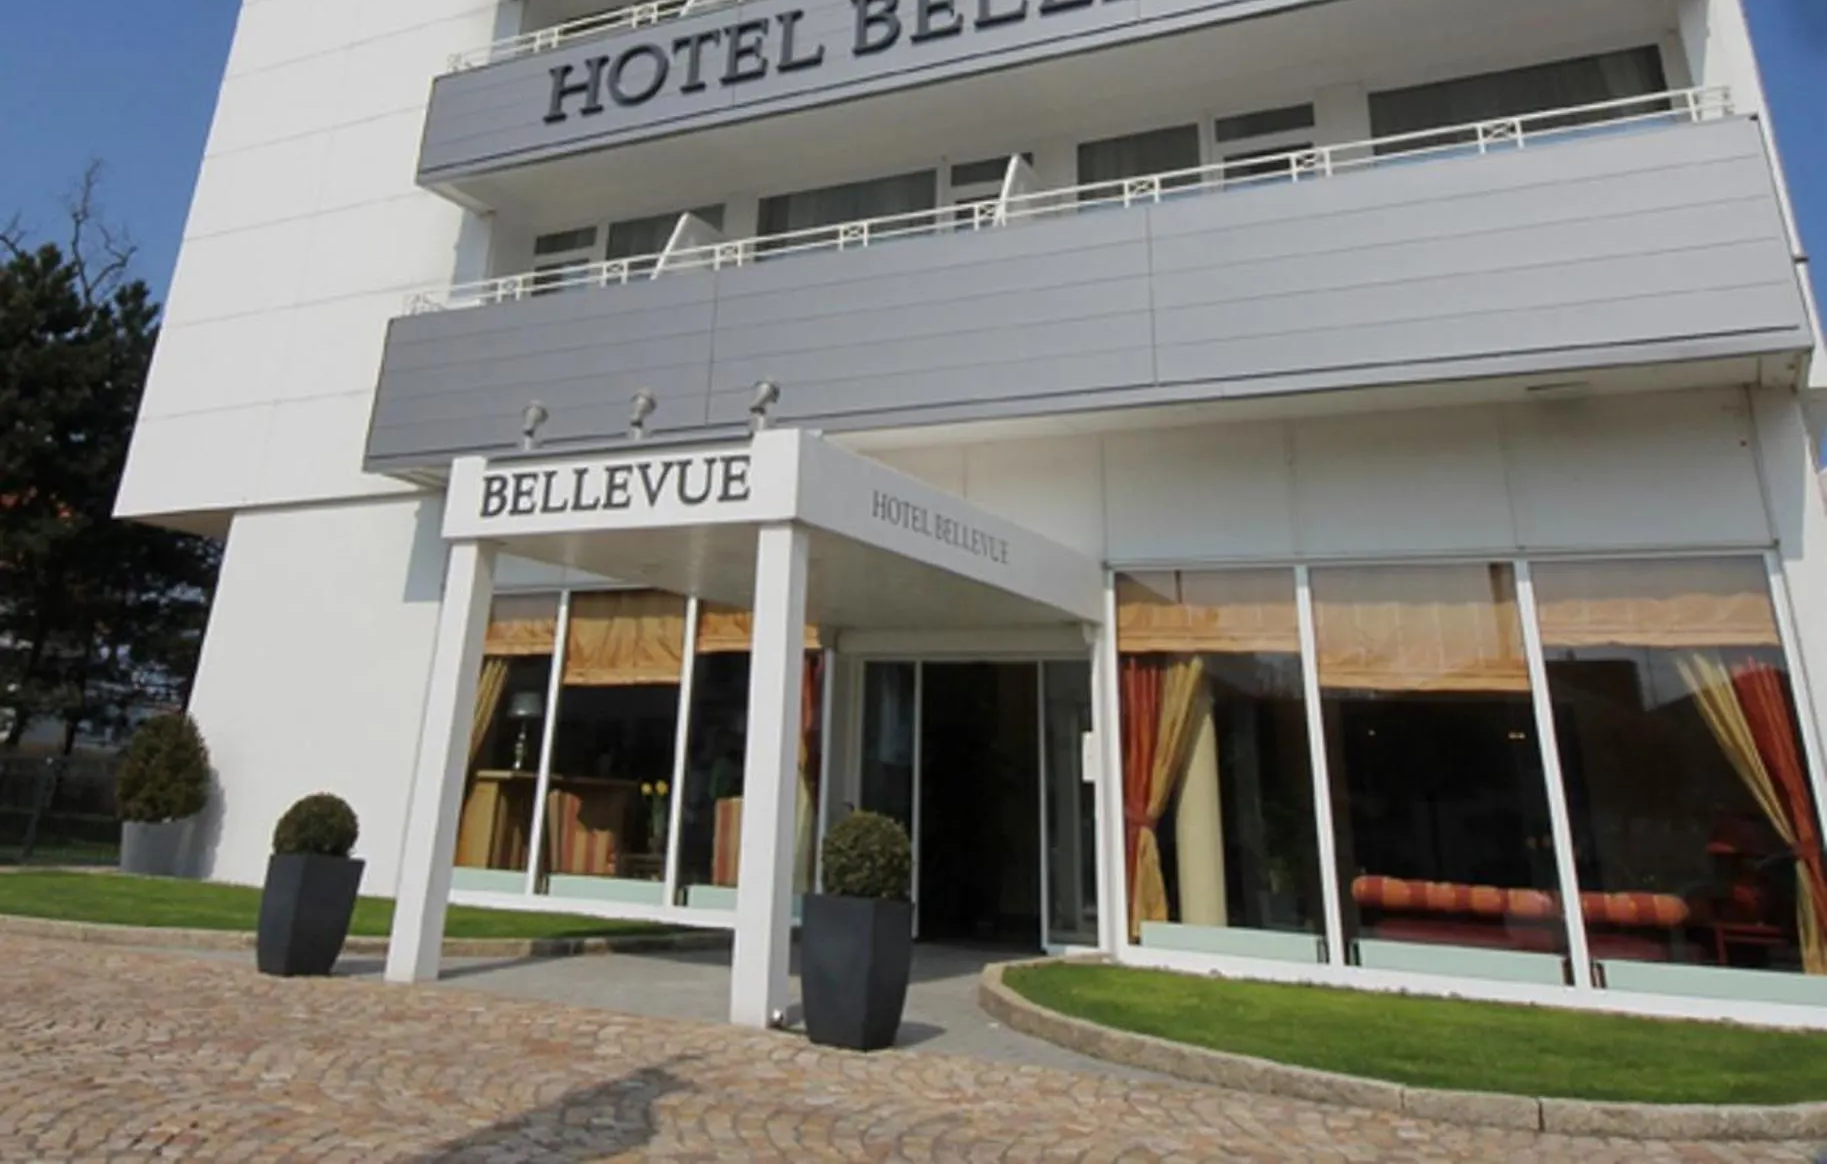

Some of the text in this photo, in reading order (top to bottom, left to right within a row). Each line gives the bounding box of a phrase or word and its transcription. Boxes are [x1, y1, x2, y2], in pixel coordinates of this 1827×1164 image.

[542, 10, 823, 124] HOTEL
[480, 455, 751, 518] BELLEVUE
[871, 489, 1009, 565] HOTEL BELLEVUE
